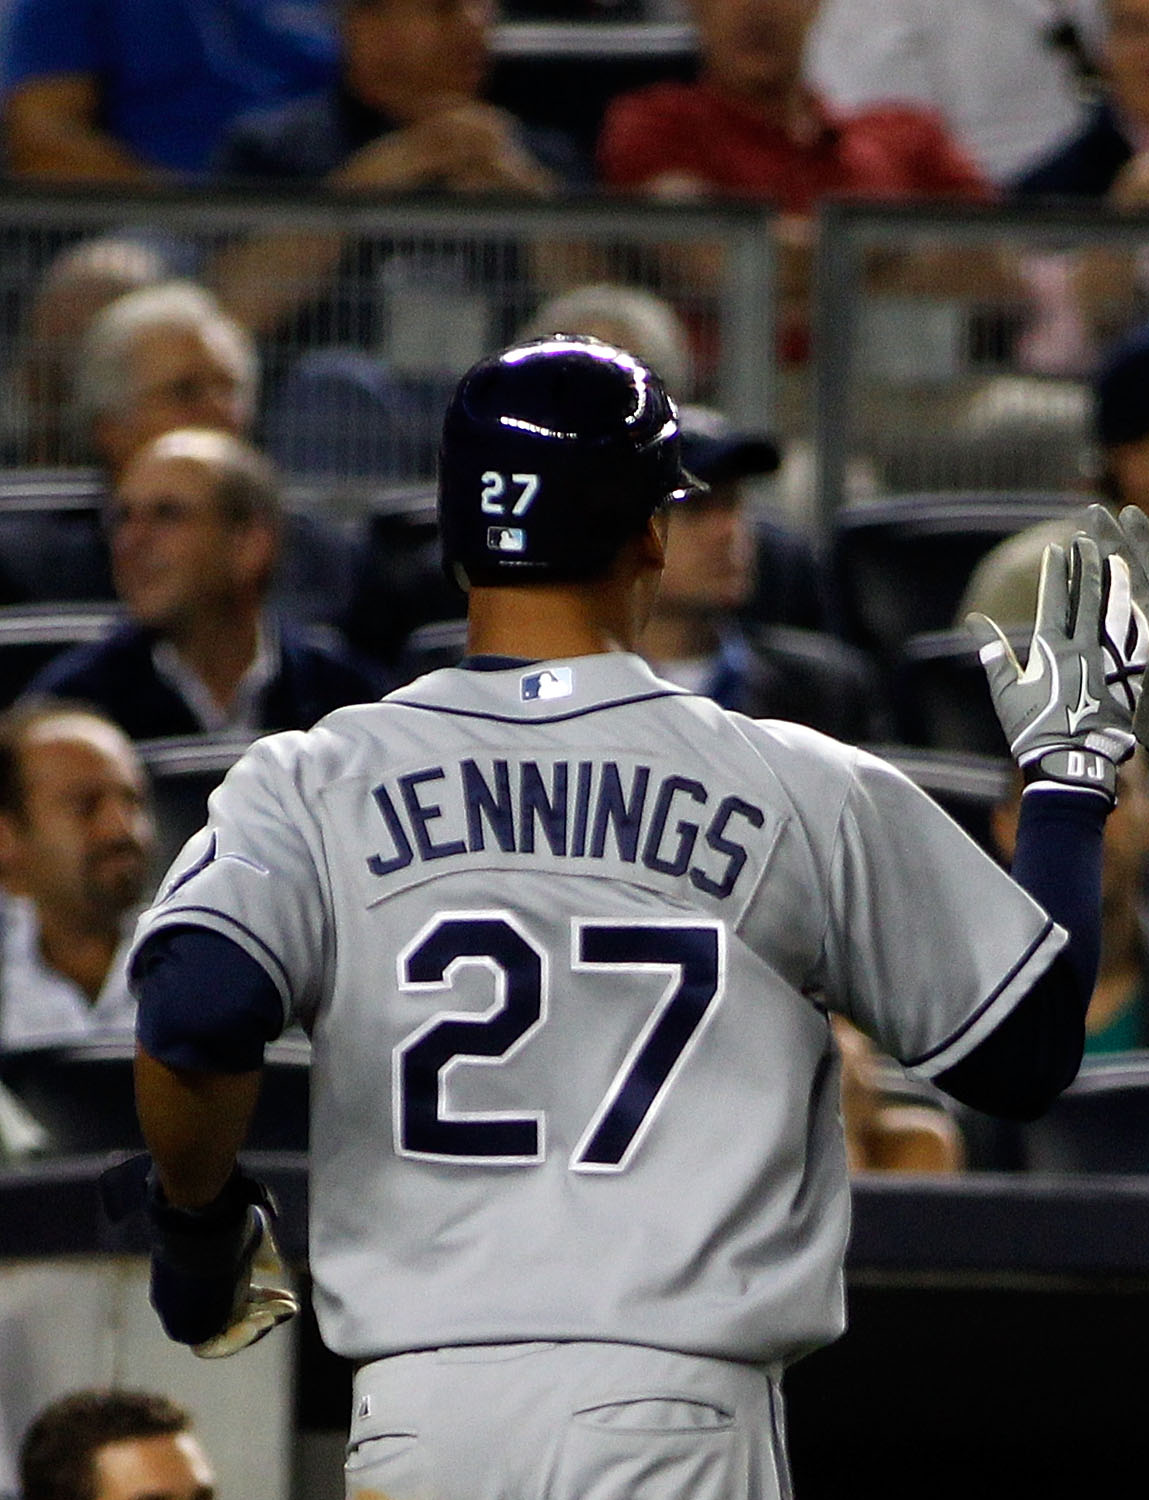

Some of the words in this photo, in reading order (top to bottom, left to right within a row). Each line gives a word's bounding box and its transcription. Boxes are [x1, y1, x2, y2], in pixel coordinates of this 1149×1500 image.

[480, 470, 541, 516] 27
[1066, 750, 1106, 780] DJ
[366, 757, 766, 900] JENNINGS
[392, 909, 728, 1176] 27
